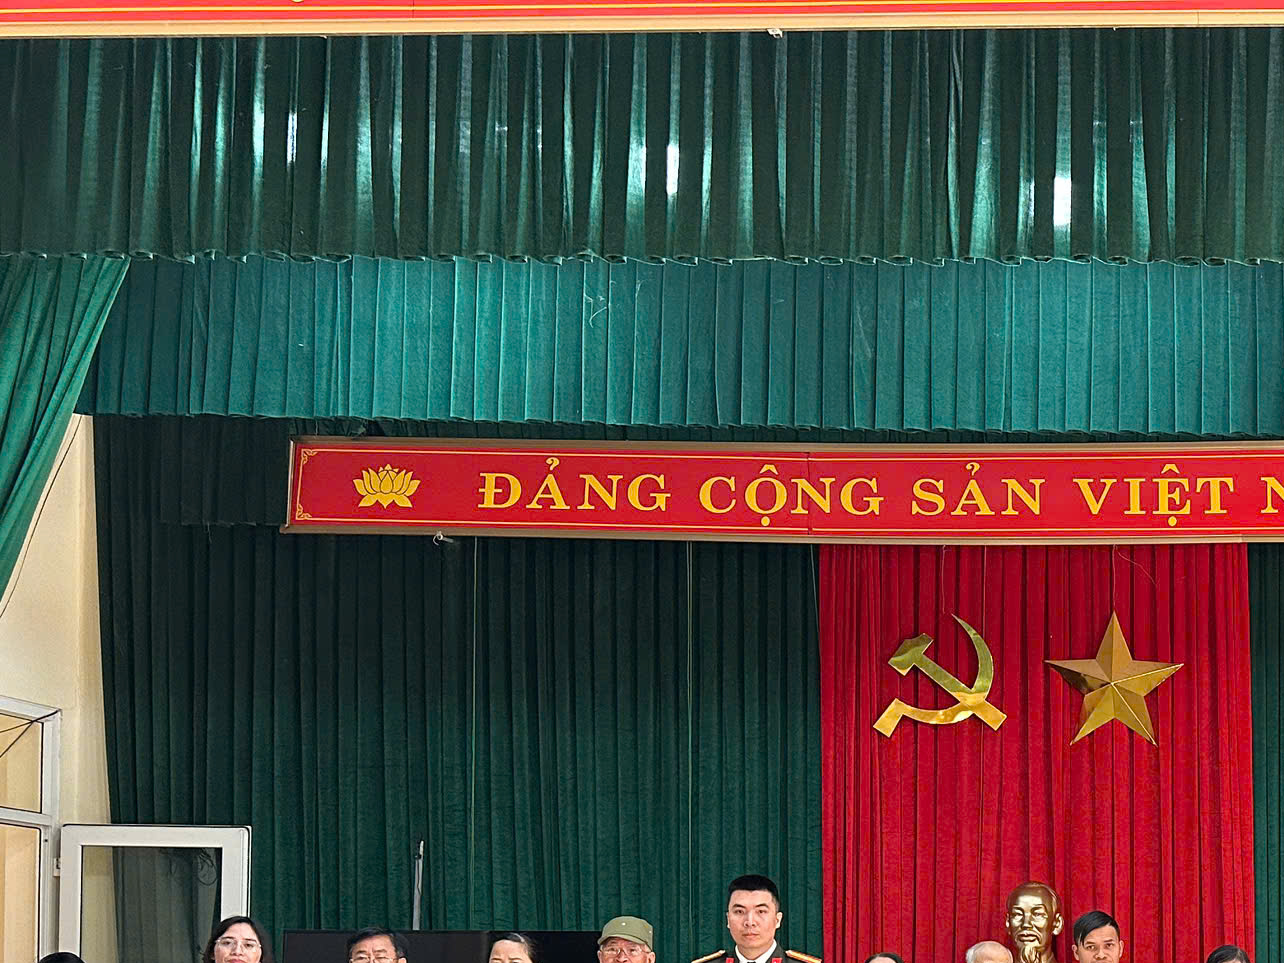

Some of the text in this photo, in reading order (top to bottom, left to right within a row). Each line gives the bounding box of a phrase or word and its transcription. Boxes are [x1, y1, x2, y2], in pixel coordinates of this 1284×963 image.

[478, 457, 672, 511] ĐẢNG
[699, 464, 885, 527] CỘNG
[910, 462, 1047, 517] SẢN
[1073, 464, 1234, 527] VIỆT
